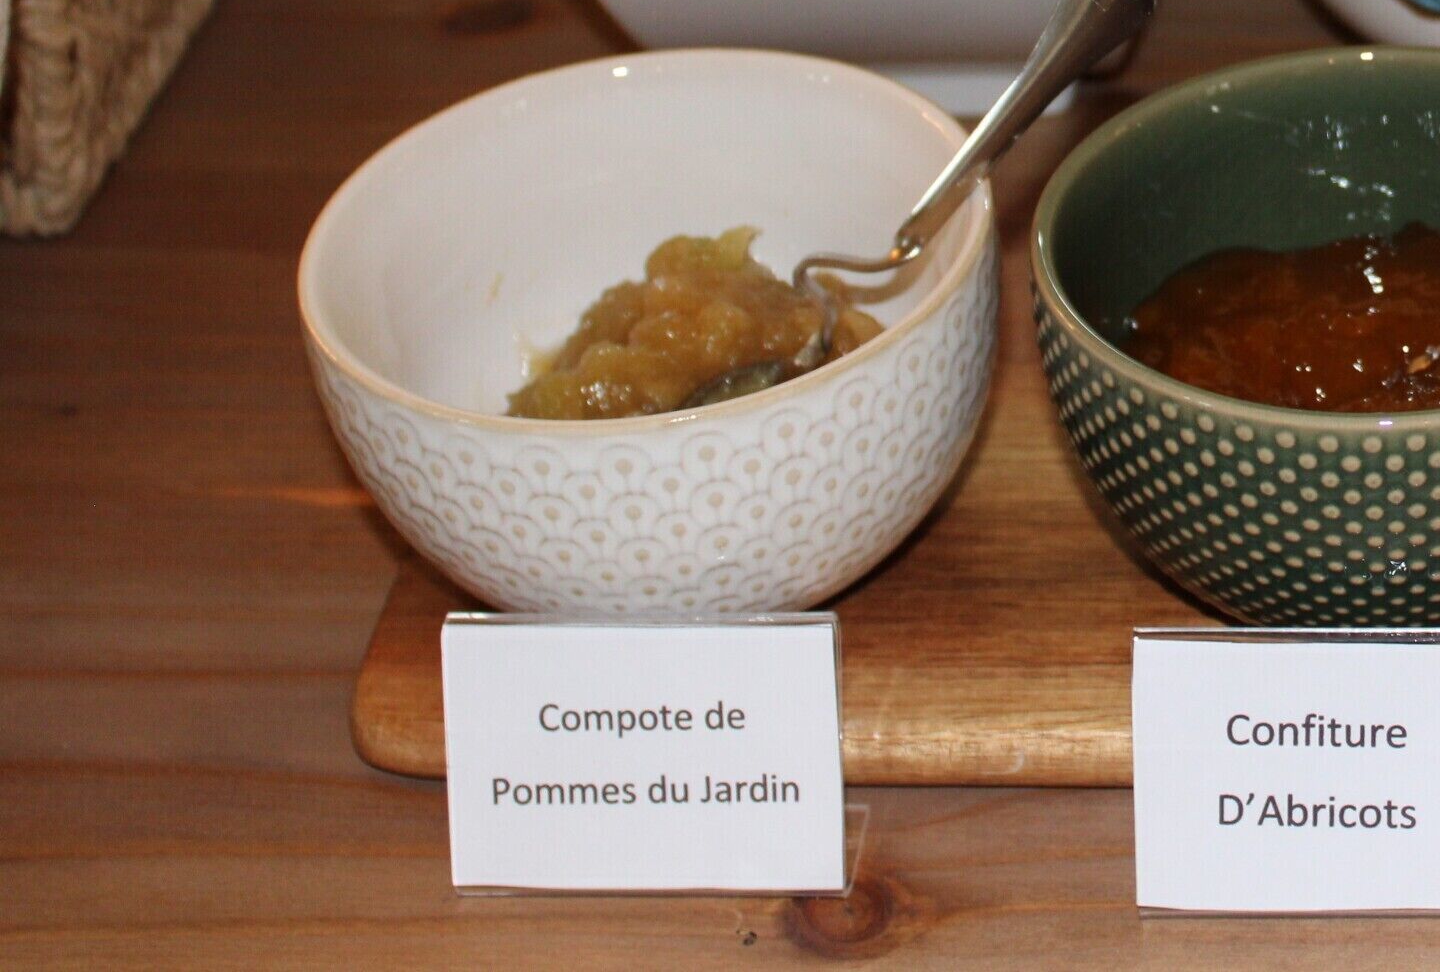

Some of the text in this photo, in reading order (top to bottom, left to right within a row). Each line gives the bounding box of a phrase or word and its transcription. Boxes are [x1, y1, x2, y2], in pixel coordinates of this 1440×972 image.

[538, 700, 746, 739] Compote de
[1226, 713, 1408, 749] Confiture
[492, 773, 800, 806] Pommes du Jardin
[1218, 792, 1417, 830] D’Abricots
